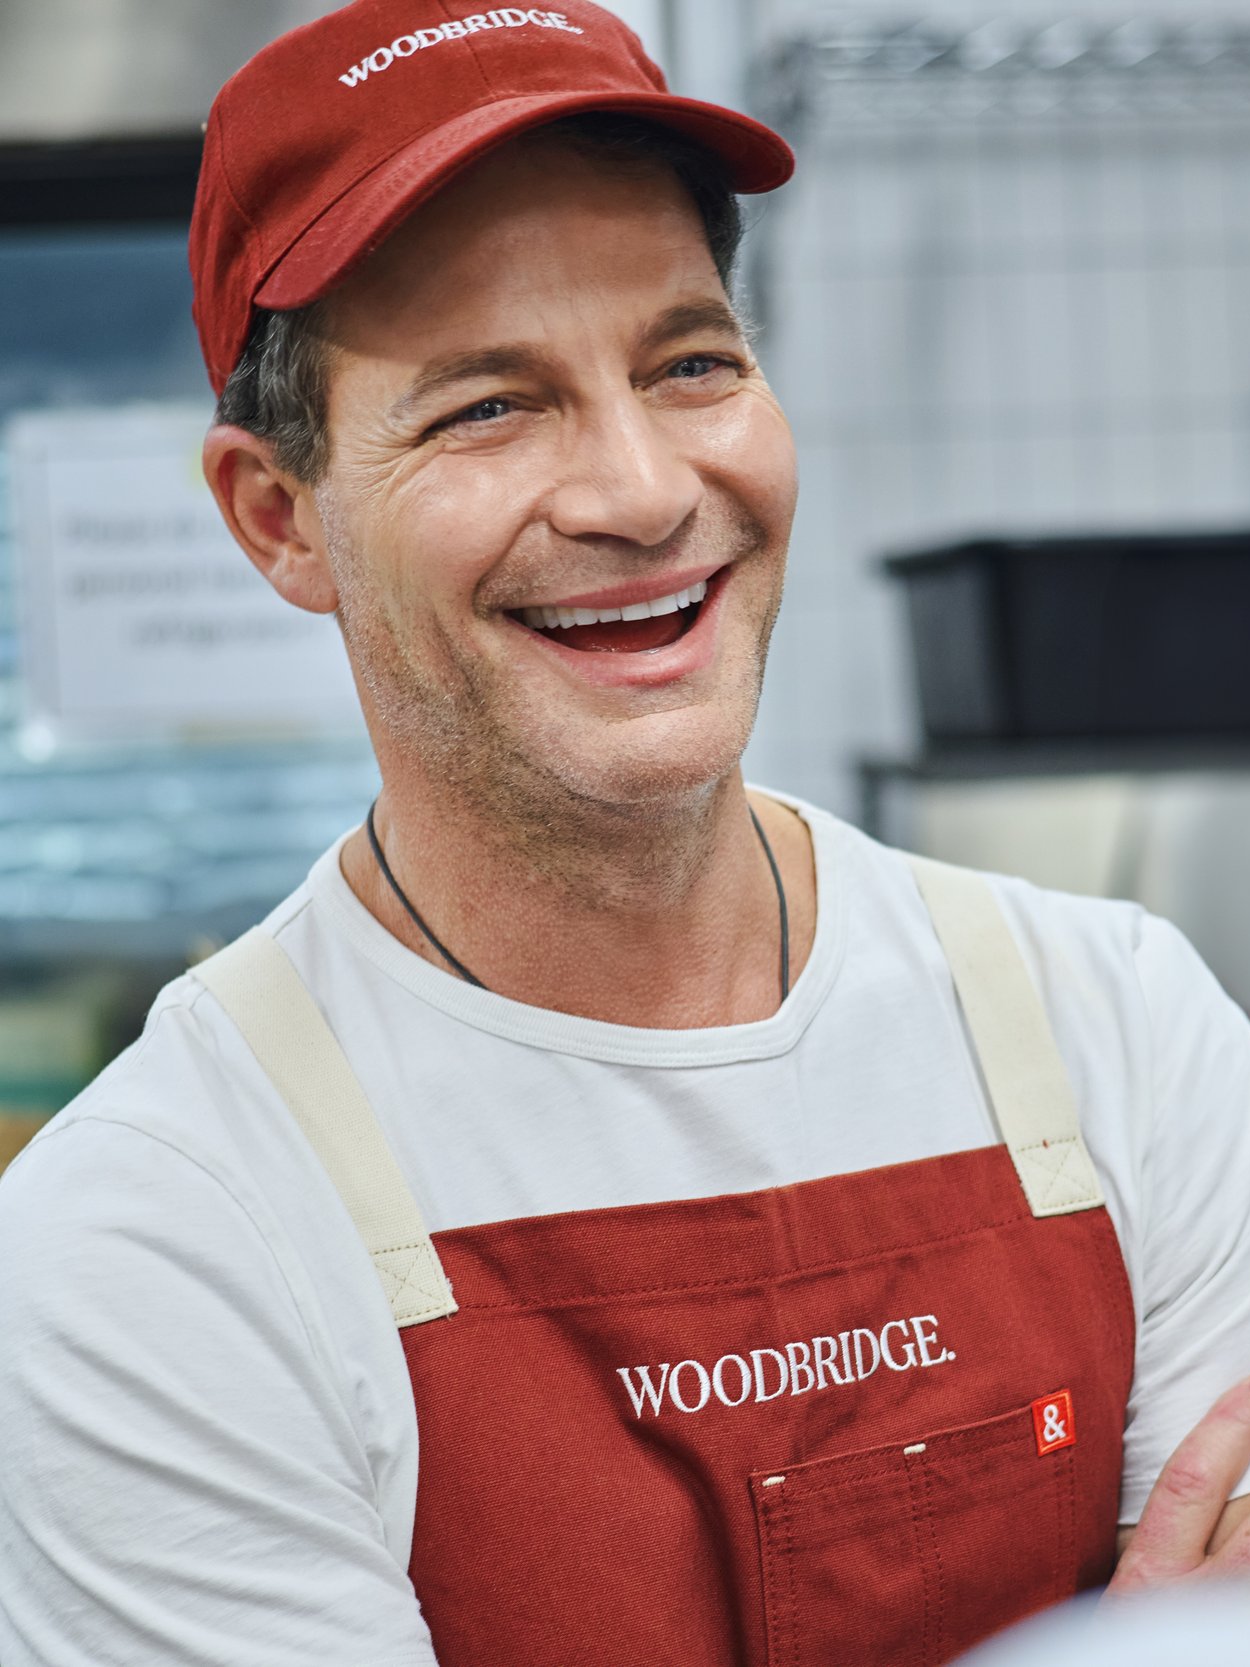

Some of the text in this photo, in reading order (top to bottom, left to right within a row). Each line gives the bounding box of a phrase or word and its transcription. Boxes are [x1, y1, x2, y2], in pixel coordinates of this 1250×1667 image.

[338, 7, 584, 88] WOODBRIDGE.
[616, 1315, 956, 1419] WOODBRIDGE.
[1043, 1404, 1067, 1443] &
